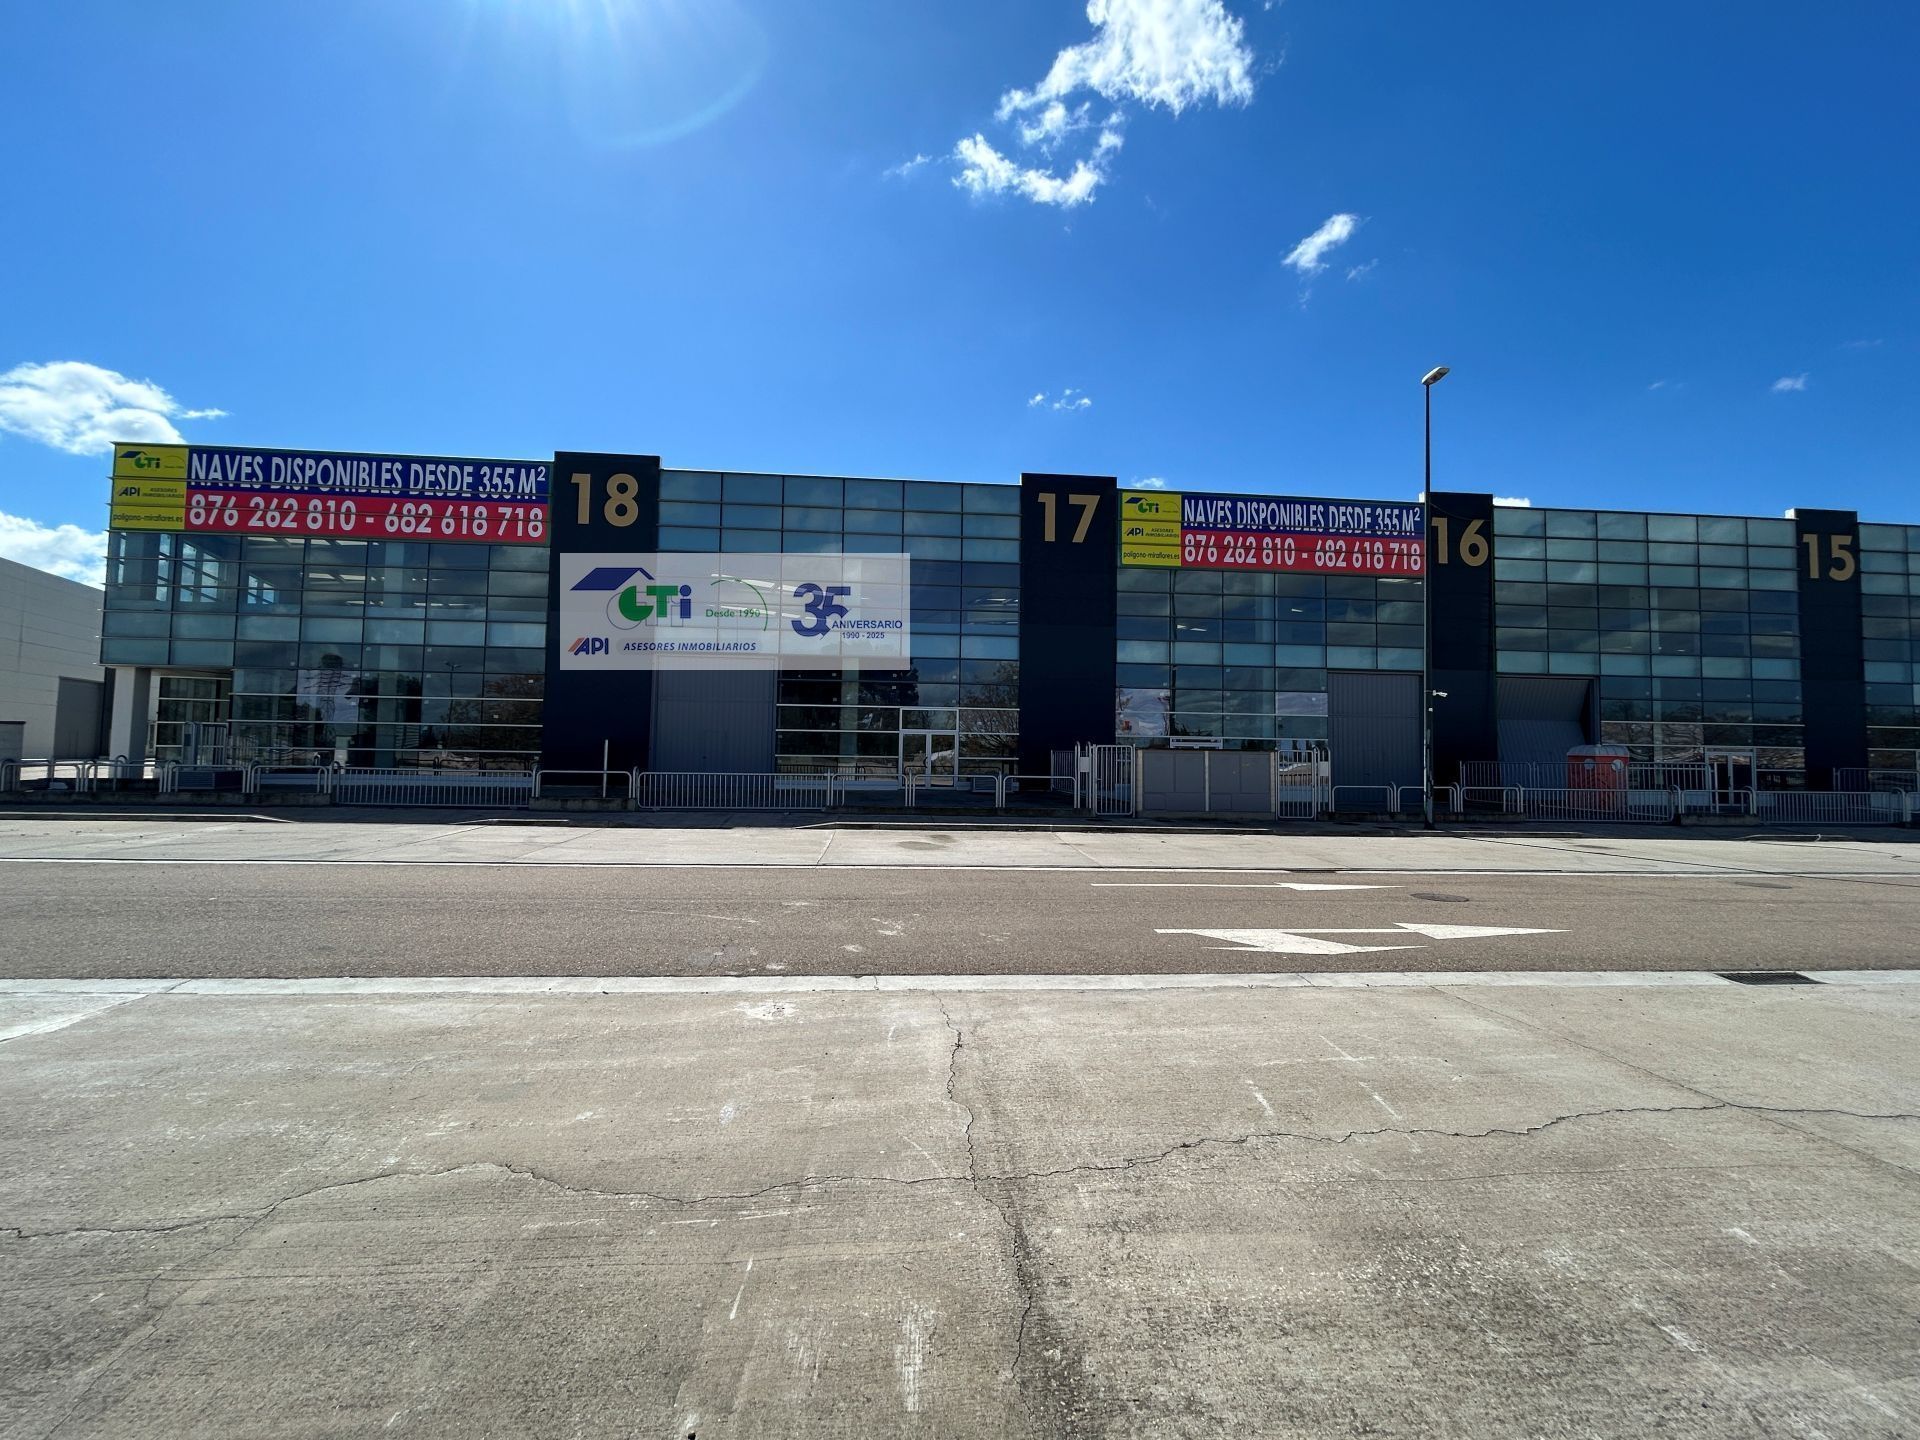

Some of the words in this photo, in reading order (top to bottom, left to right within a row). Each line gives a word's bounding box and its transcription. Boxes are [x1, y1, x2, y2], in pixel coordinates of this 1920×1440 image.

[118, 486, 141, 497] API
[190, 453, 264, 489] NAVES
[270, 456, 403, 494] DISPONIBLES
[409, 463, 474, 497] DESDE
[478, 465, 515, 499] 355
[189, 494, 239, 526] 876
[247, 496, 299, 528] 262
[306, 498, 357, 531] 810
[384, 502, 433, 534] 682
[440, 504, 488, 536] 618
[497, 506, 543, 538] 718
[570, 472, 639, 527] 18
[1037, 492, 1101, 543] 17
[1184, 498, 1232, 529] NAVES
[1236, 501, 1325, 533] DISPONIBLES
[1328, 505, 1372, 534] DESDE
[1375, 507, 1400, 536] 355
[1126, 527, 1144, 537] API
[1184, 533, 1218, 562] 876
[1223, 535, 1257, 564] 262
[1262, 536, 1296, 566] 810
[1314, 539, 1347, 567] 682
[1352, 541, 1385, 569] 618
[1389, 542, 1421, 571] 718
[1431, 516, 1489, 567] 16
[1802, 533, 1856, 581] 15
